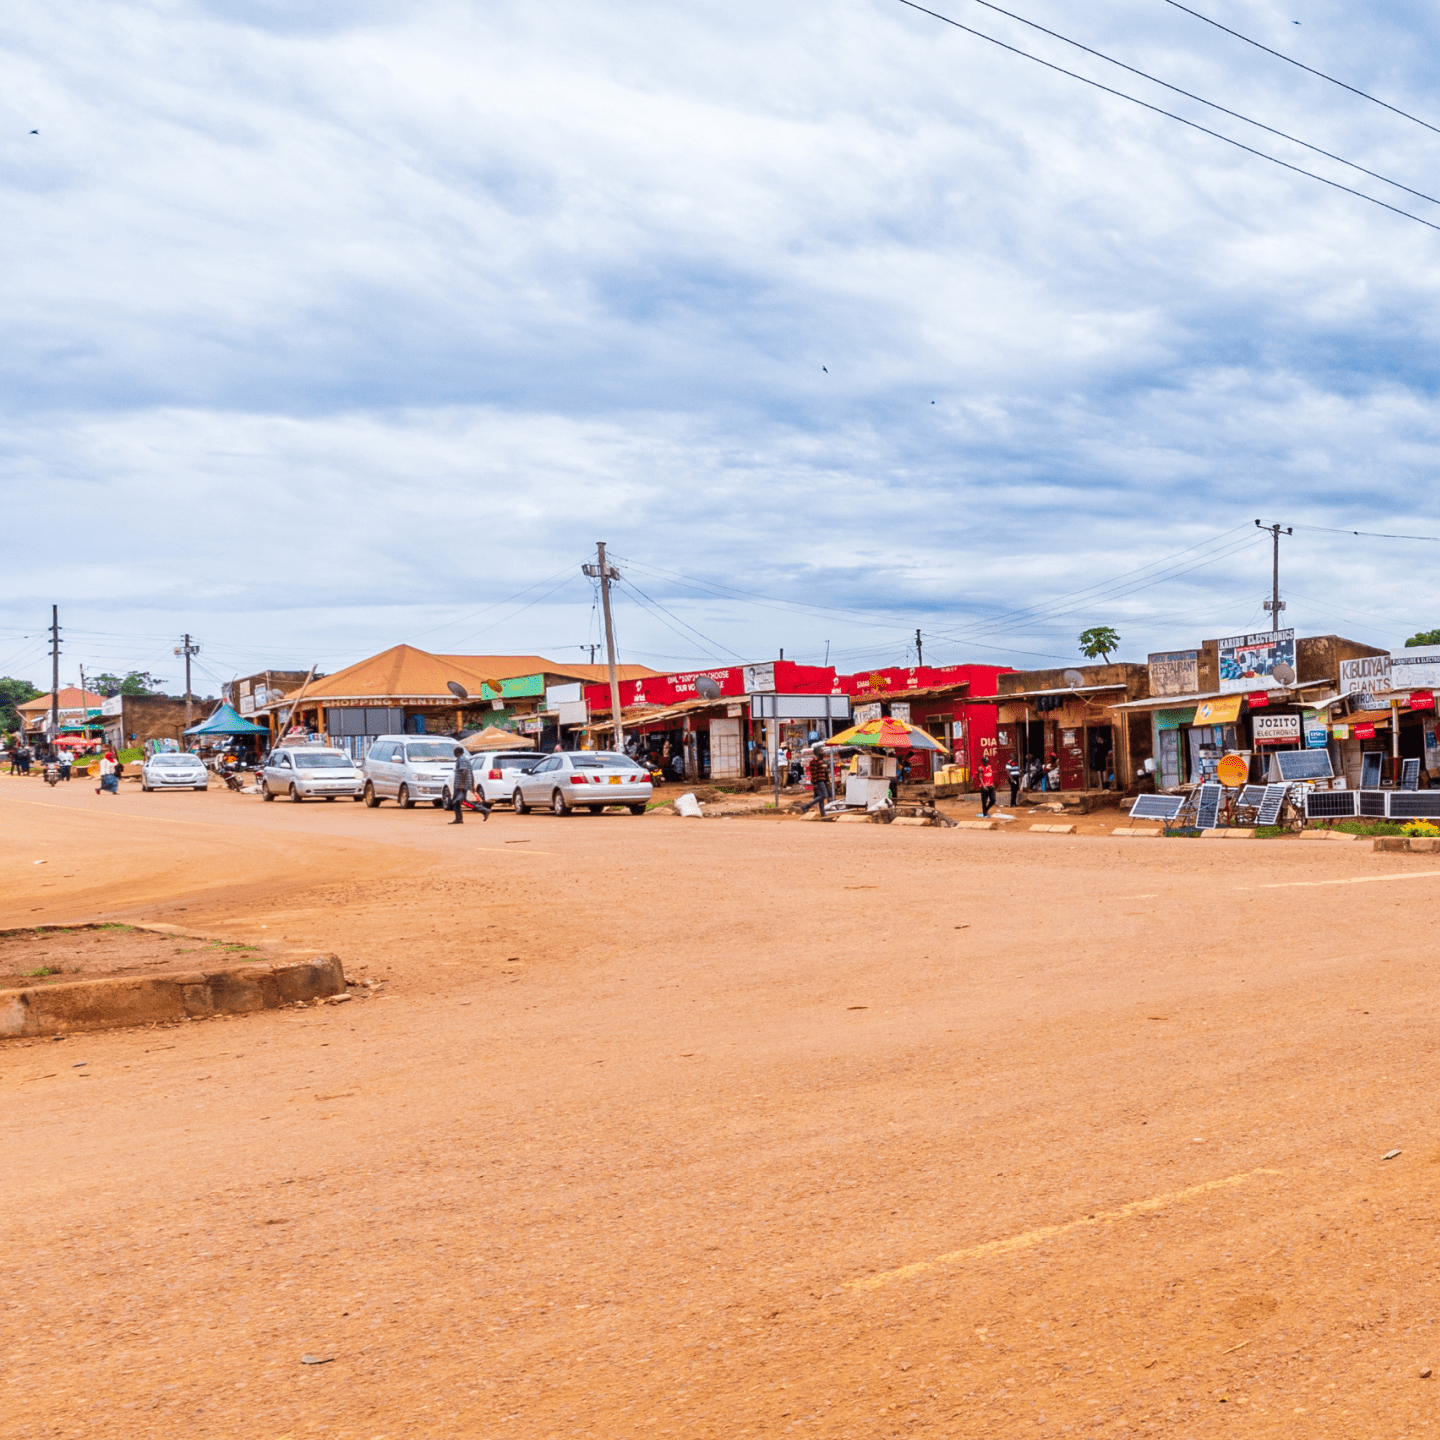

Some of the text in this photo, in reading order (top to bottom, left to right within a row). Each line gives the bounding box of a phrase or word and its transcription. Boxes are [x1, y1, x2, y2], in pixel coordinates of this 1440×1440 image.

[1220, 635, 1245, 650] KARIBU
[1247, 629, 1294, 646] ELECTRONICS
[1152, 660, 1197, 675] RESTAURANT
[1349, 677, 1391, 693] GIANTS
[322, 698, 392, 708] SHOPPING
[400, 698, 455, 706] CENTRE
[1258, 717, 1298, 728] JOZITO
[1256, 728, 1299, 737] ELECTRONICS
